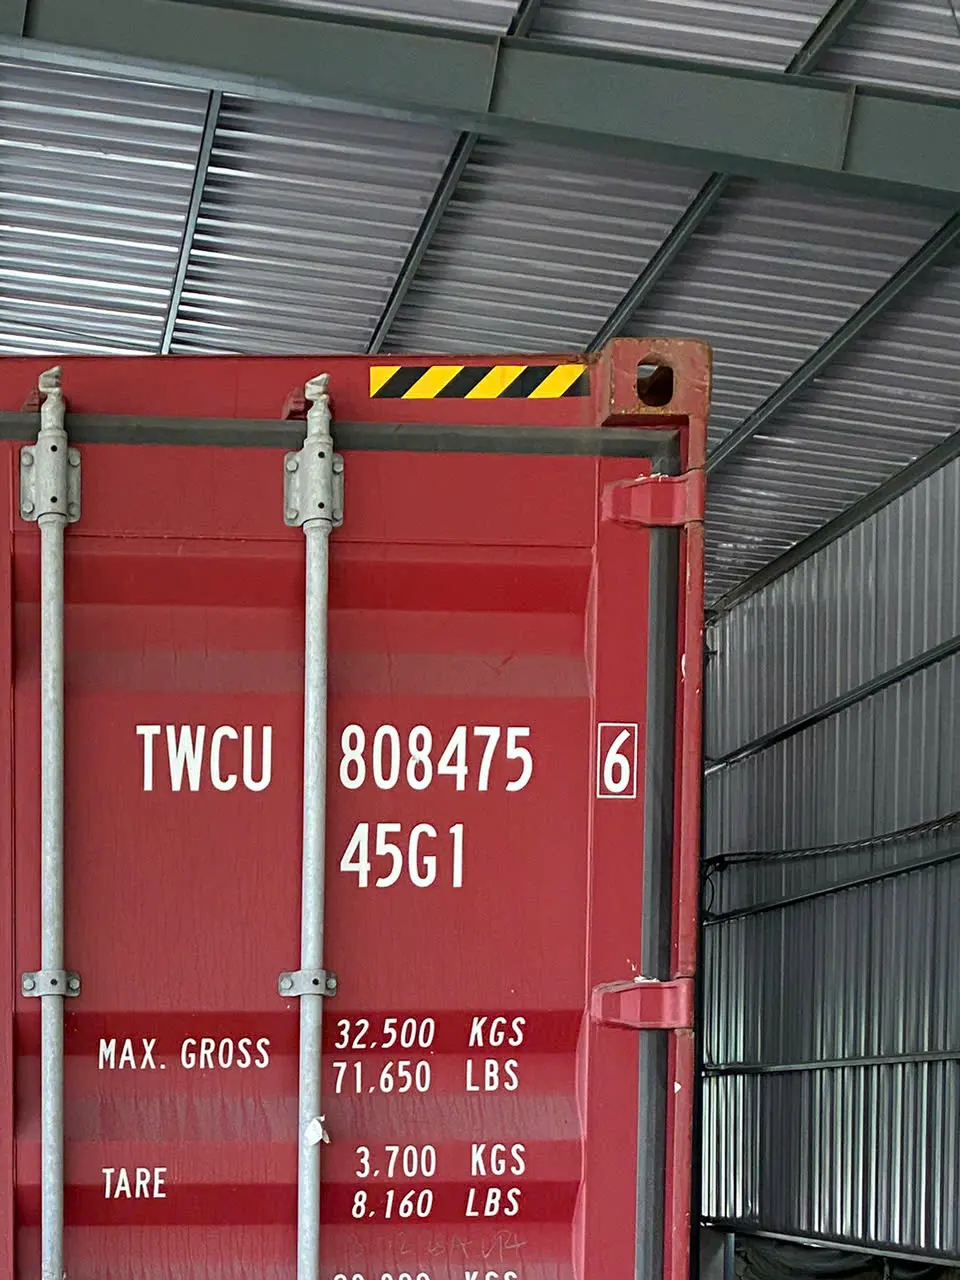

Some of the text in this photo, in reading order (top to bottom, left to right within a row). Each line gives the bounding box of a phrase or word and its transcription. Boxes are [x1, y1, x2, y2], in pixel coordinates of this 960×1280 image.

[137, 725, 630, 792] TWCU 808475 6
[340, 823, 464, 887] 45G1
[98, 1038, 165, 1069] MAX.
[181, 1038, 270, 1068] GROSS
[469, 1017, 526, 1046] KGS
[467, 1060, 519, 1091] LBS
[102, 1168, 167, 1198] TARE
[471, 1144, 526, 1175] KGS
[465, 1188, 521, 1217] LBS
